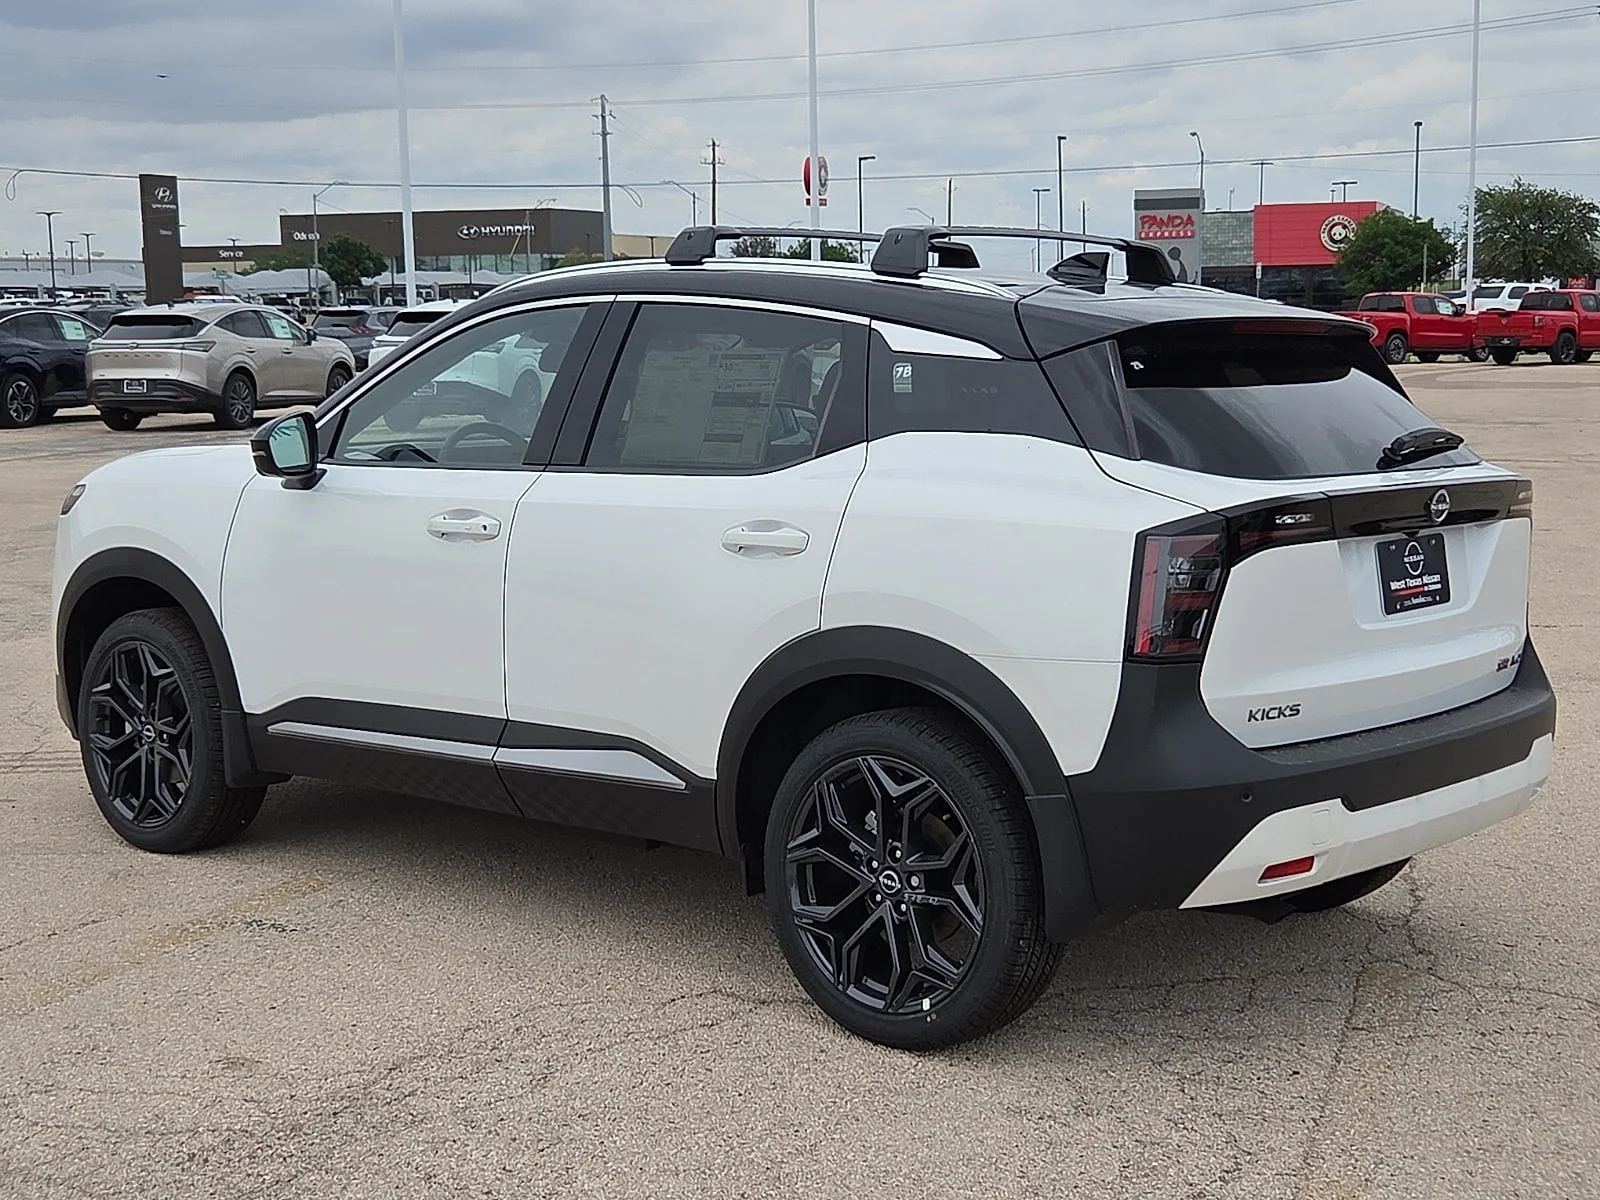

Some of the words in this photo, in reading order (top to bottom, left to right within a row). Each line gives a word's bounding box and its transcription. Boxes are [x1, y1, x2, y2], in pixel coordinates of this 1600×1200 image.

[1139, 214, 1194, 230] PANDA
[1141, 230, 1192, 238] EXPRESS
[1247, 703, 1302, 723] KICKS
